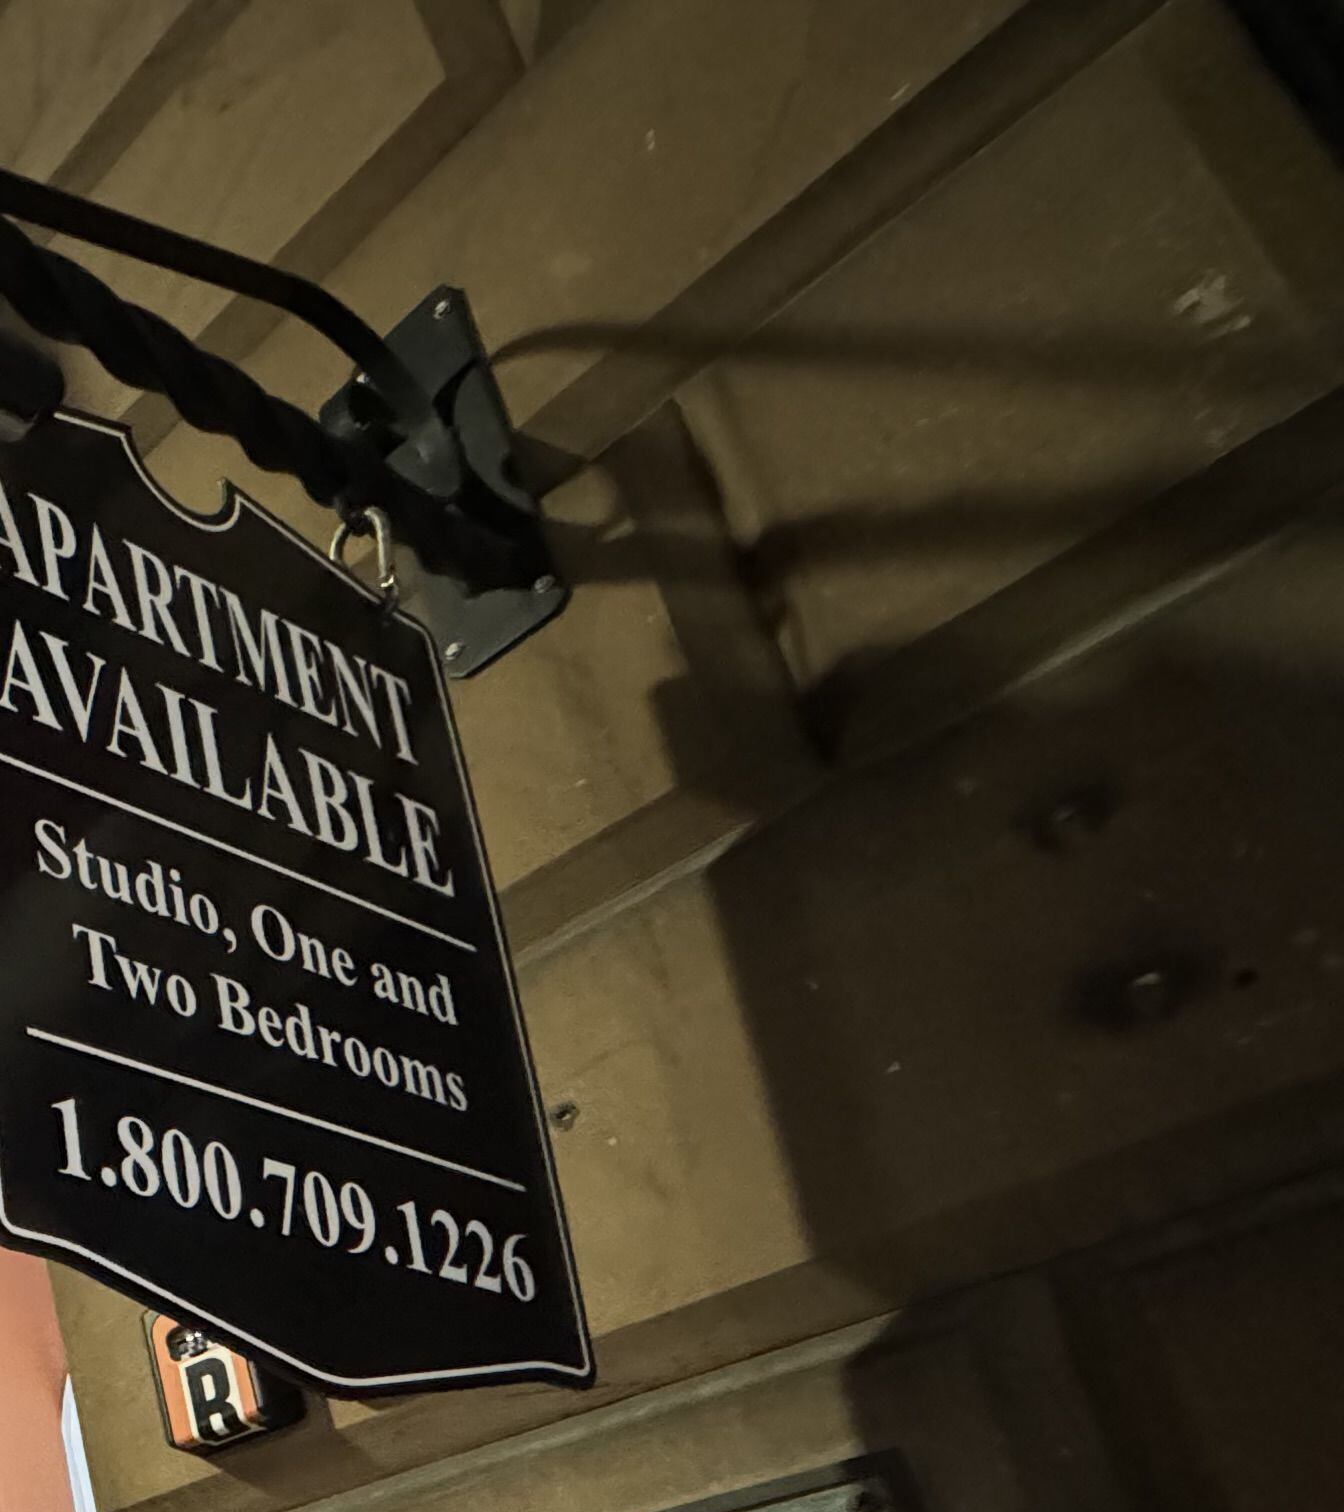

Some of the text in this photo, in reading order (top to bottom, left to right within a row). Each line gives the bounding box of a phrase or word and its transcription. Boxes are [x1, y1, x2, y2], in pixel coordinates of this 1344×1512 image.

[33, 818, 460, 1026] Studio, One and
[72, 923, 470, 1113] Two Bedrooms
[51, 1098, 537, 1302] 1.800.709.1226
